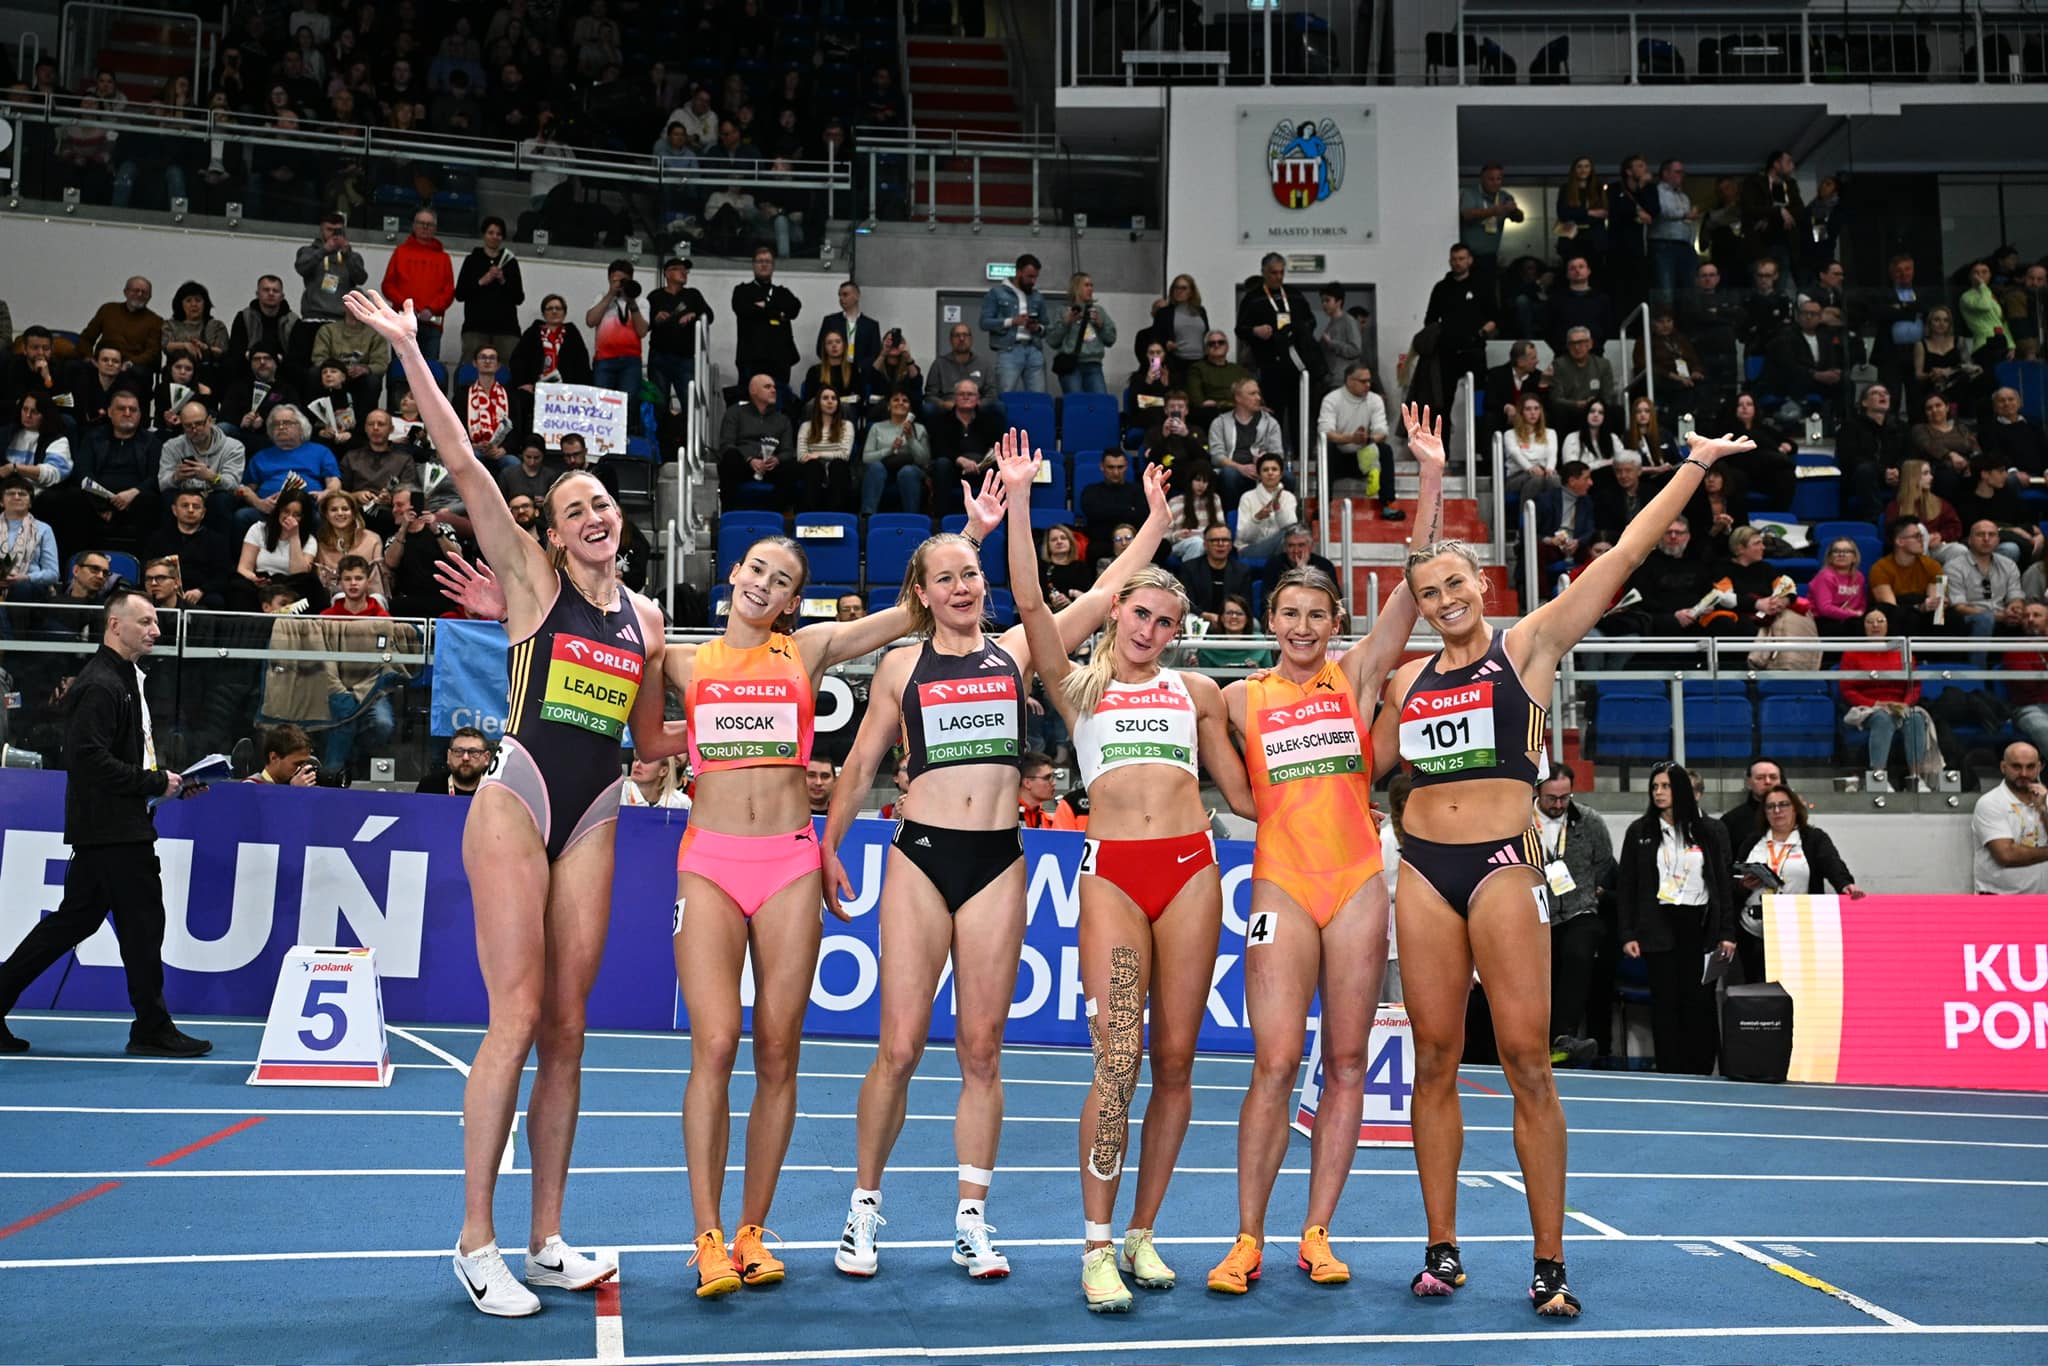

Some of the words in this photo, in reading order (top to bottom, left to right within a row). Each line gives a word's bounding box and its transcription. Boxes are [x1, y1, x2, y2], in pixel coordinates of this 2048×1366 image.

[1268, 227, 1309, 237] MIASTO
[592, 650, 640, 675] ORLEN
[563, 676, 628, 708] LEADER
[733, 685, 787, 697] ORLEN
[956, 682, 1007, 695] ORLEN
[1128, 693, 1180, 705] ORLEN
[1431, 690, 1480, 710] ORLEN
[546, 706, 588, 725] TORUŃ
[590, 718, 607, 731] 25
[1295, 701, 1341, 719] ORLEN
[715, 716, 774, 730] KOSCAK
[939, 713, 1005, 731] LAGGER
[1115, 719, 1169, 732] SZUCS
[1421, 717, 1470, 751] 101
[700, 743, 743, 757] TORUŃ
[746, 745, 764, 756] 25
[929, 742, 973, 760] TORUŃ
[975, 743, 993, 755] 25
[1103, 744, 1141, 758] ORUŃ
[1144, 747, 1162, 756] 25
[1265, 731, 1356, 756] SUŁEK-SCHUBERT
[1272, 762, 1315, 782] TORUŃ
[1318, 761, 1335, 774] 25
[1449, 757, 1464, 769] 25
[1081, 841, 1092, 872] 2
[1251, 913, 1268, 942] 4
[312, 962, 354, 974] polanik
[1962, 943, 2048, 993] KU
[297, 979, 348, 1052] 5
[1373, 1017, 1413, 1029] polanik
[1363, 1035, 1412, 1112] 4
